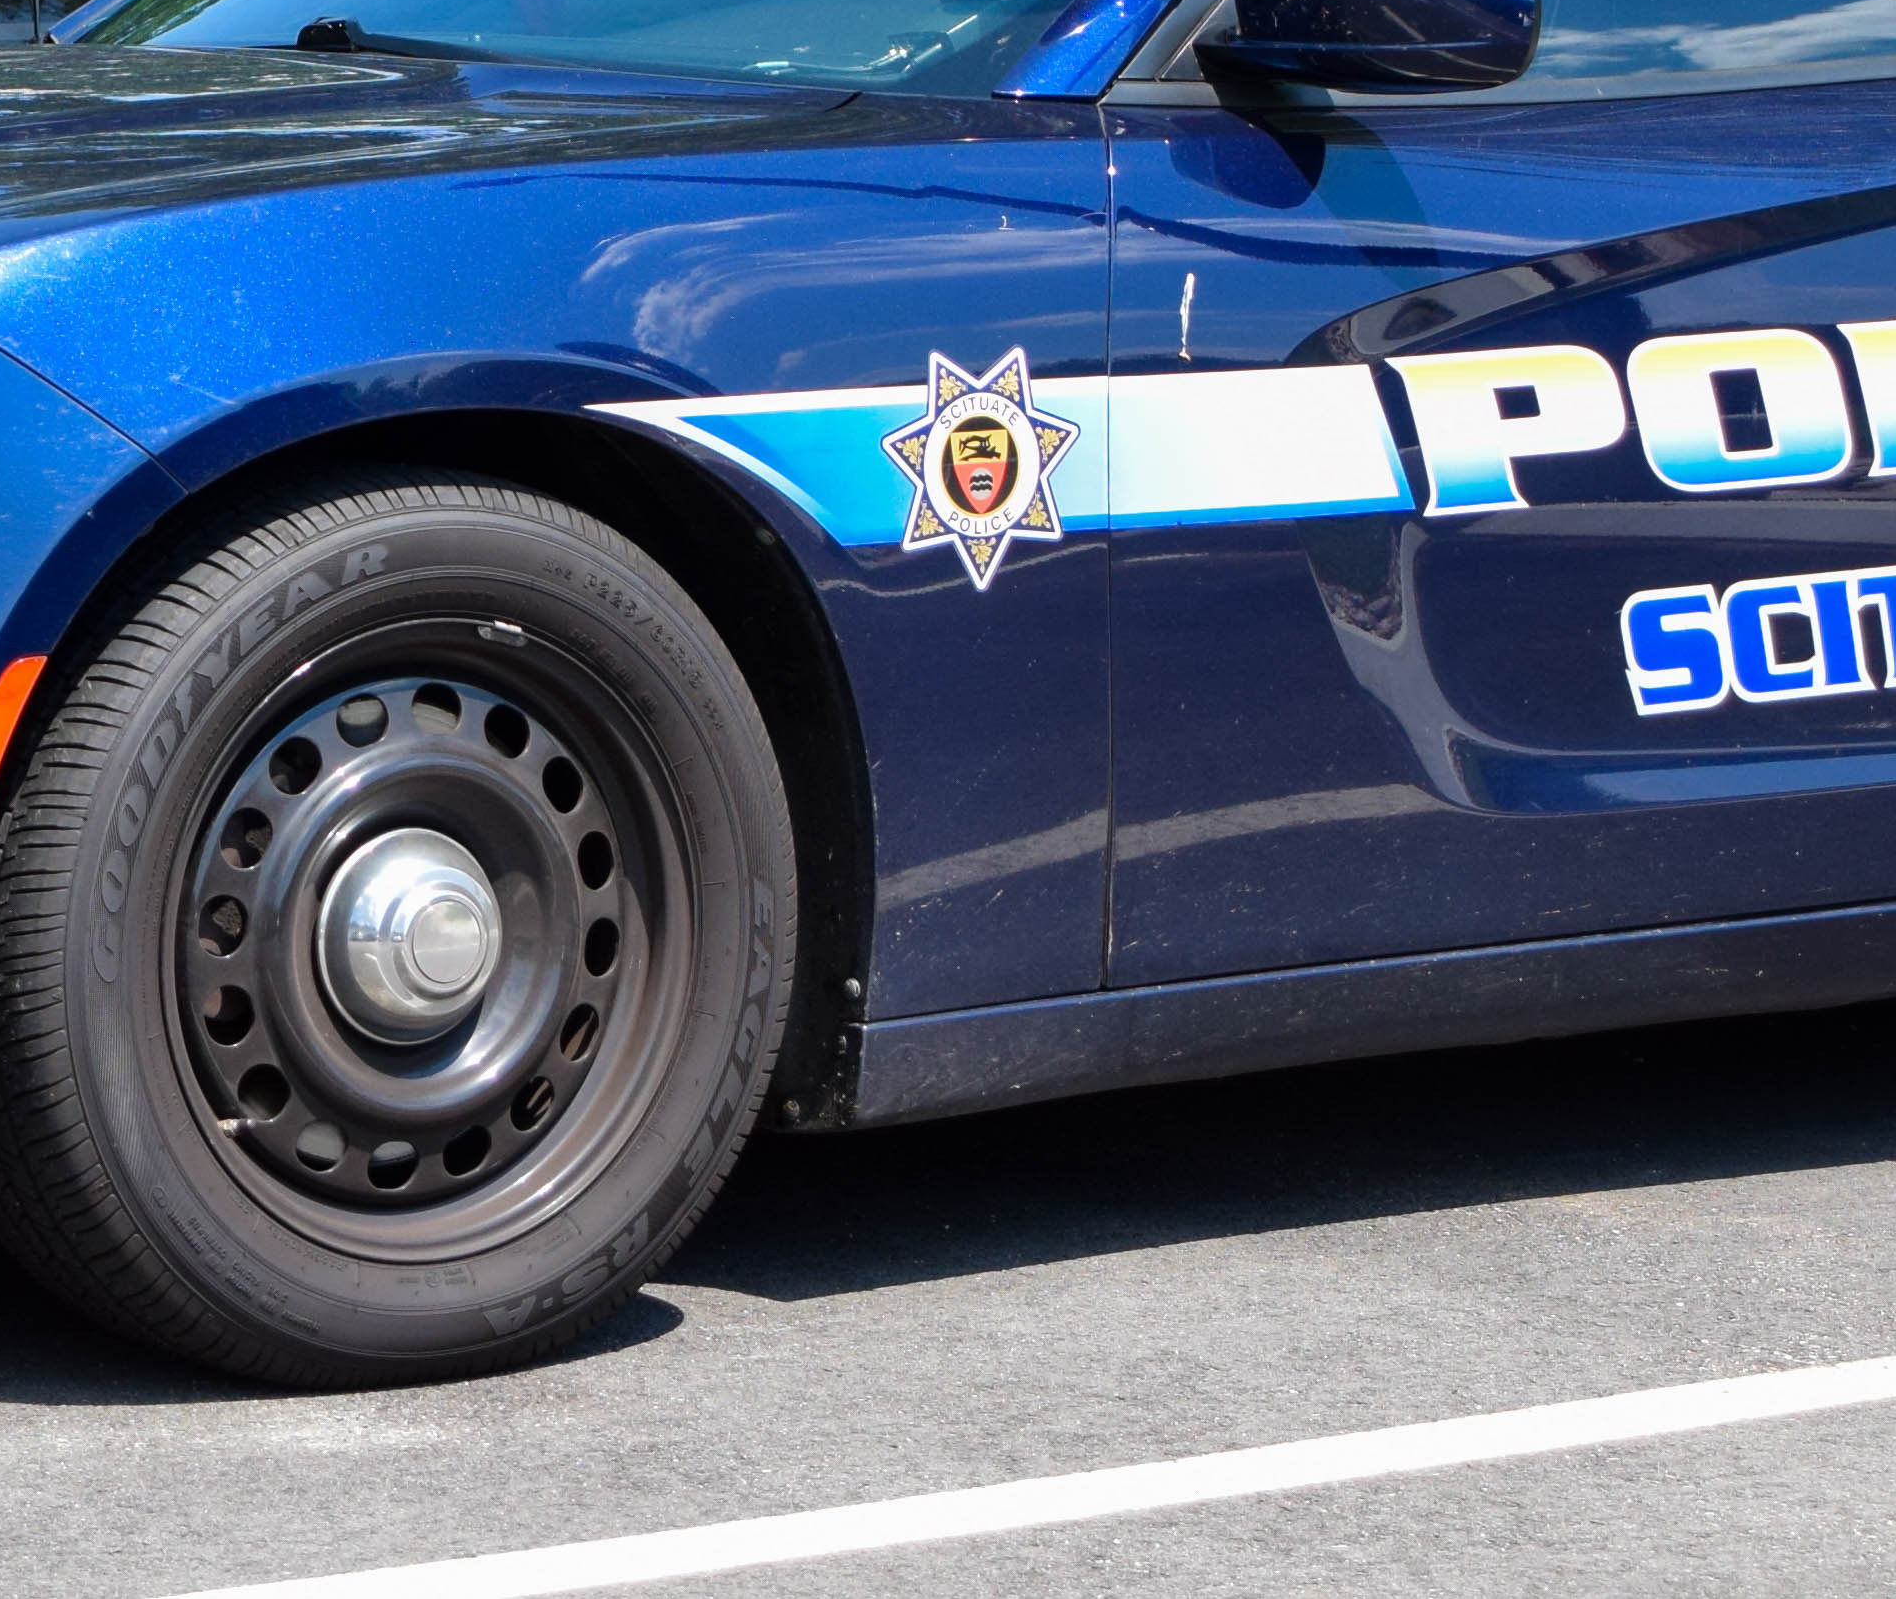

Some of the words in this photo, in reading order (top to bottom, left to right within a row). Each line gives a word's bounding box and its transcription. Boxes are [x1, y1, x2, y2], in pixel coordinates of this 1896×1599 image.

[939, 395, 1021, 431] SCITUATE
[947, 506, 1015, 535] POLICE
[91, 540, 390, 984] GOODYEAR
